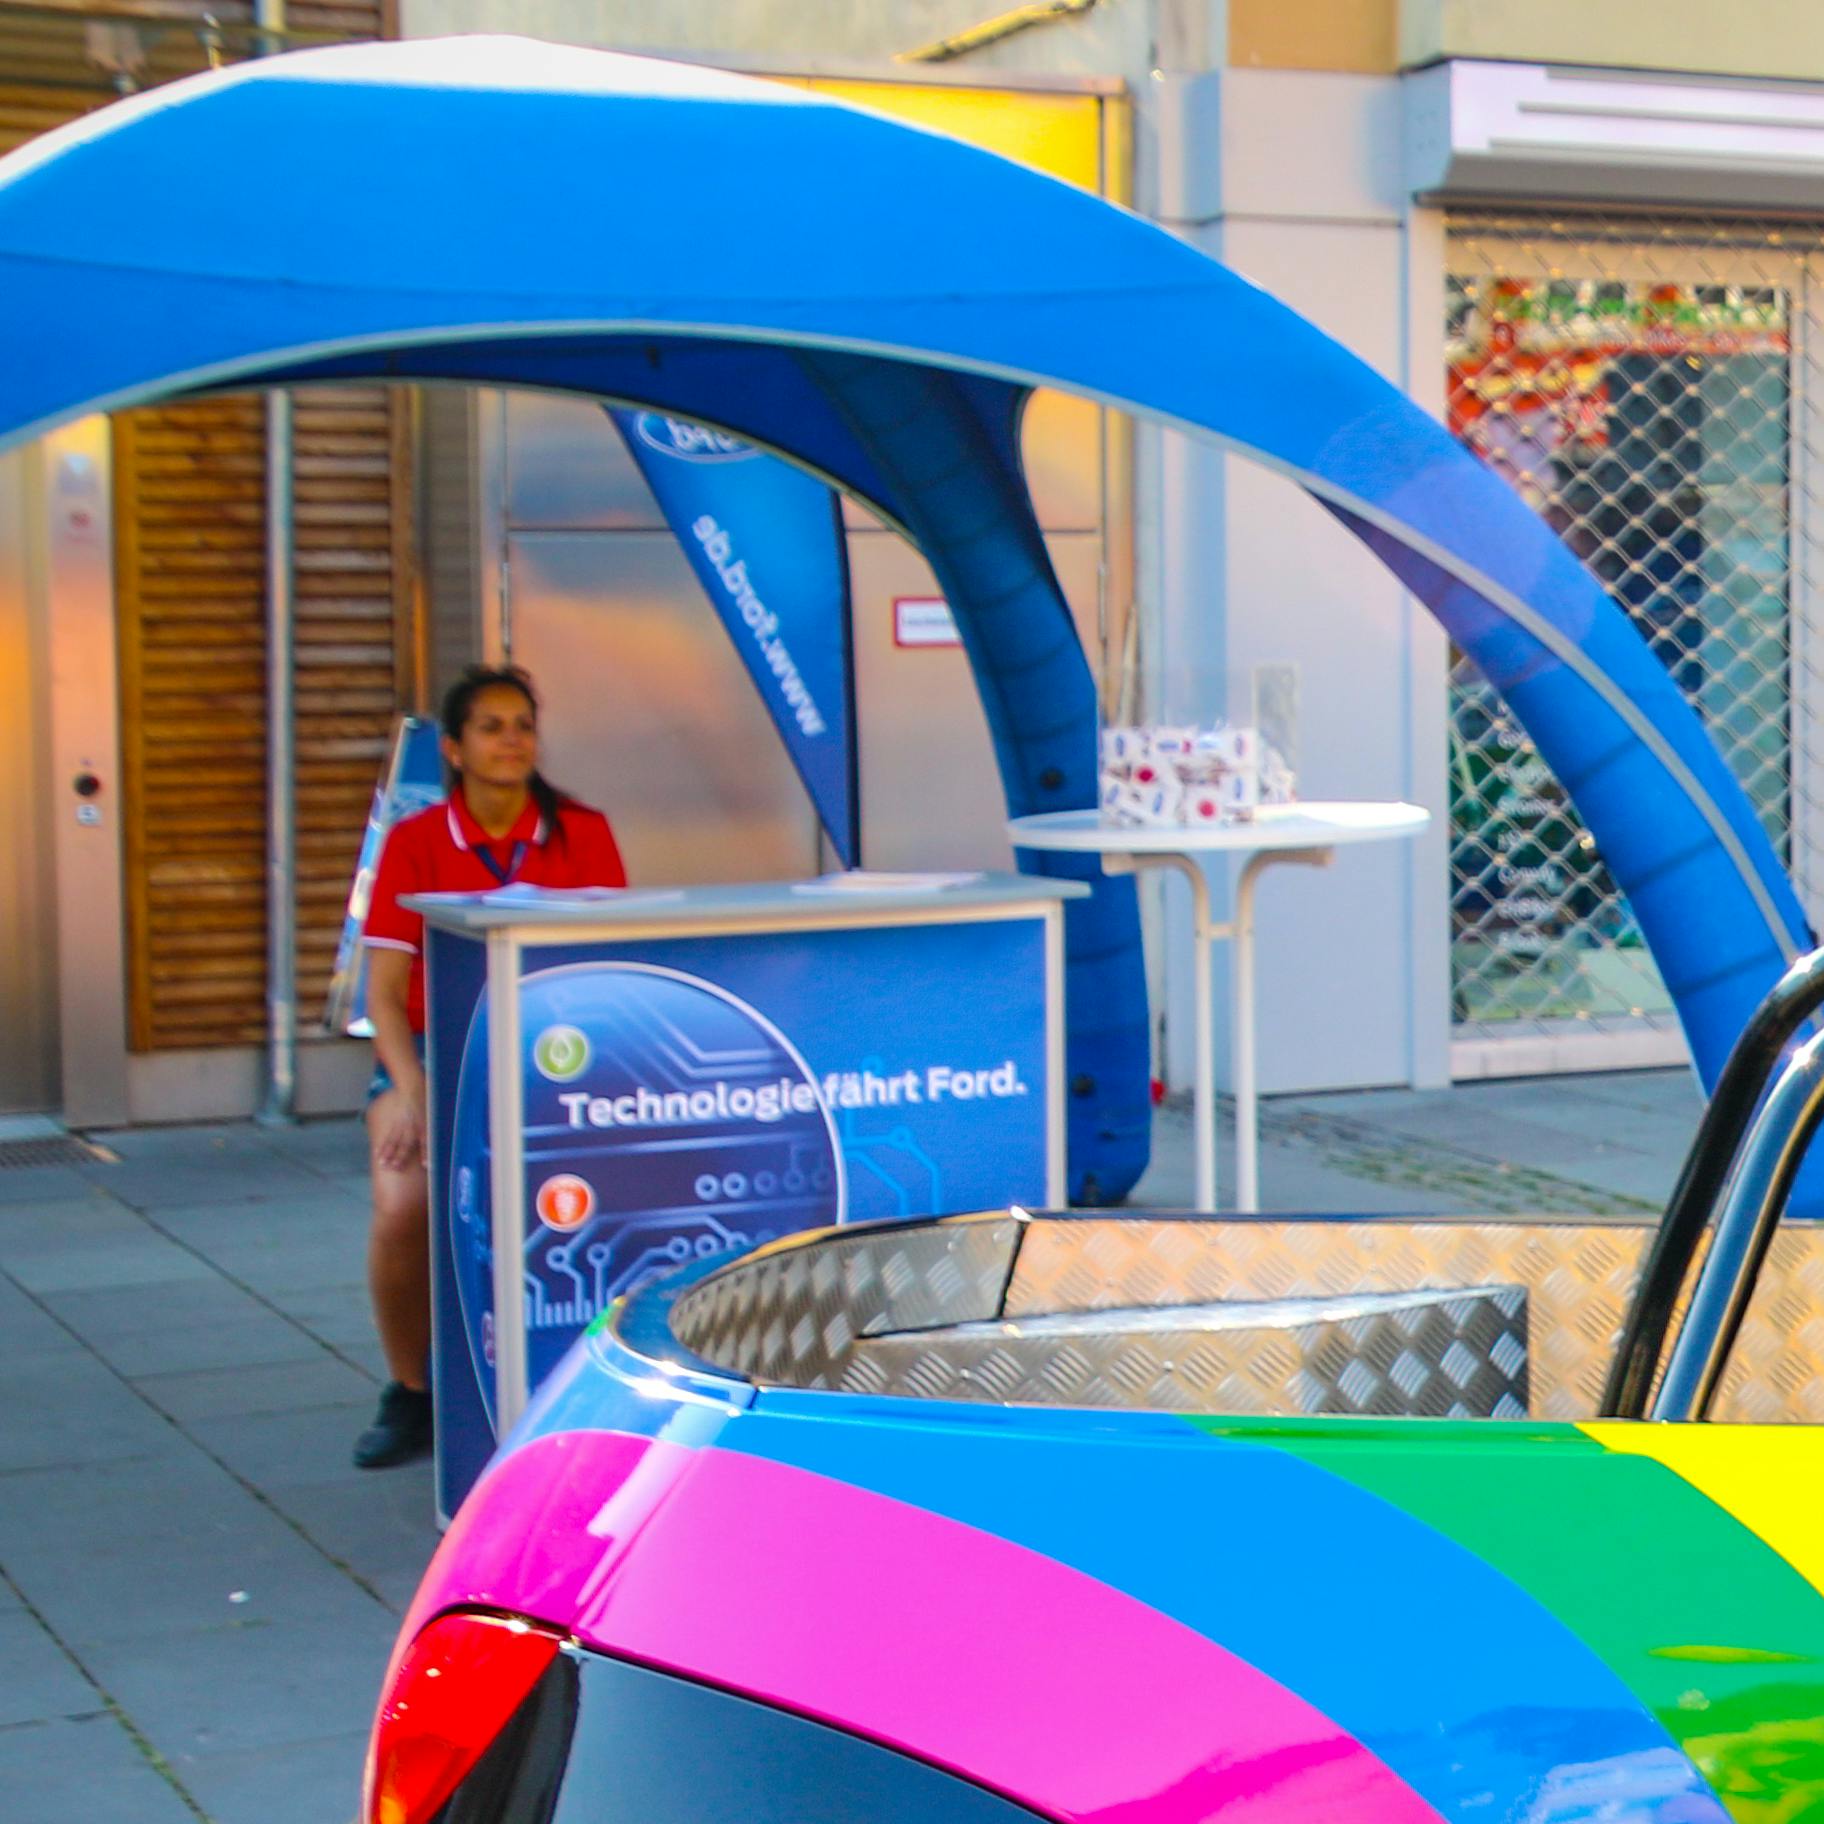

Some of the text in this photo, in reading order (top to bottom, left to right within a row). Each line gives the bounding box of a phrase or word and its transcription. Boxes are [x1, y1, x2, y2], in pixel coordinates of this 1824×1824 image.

[558, 1059, 1028, 1128] Technologie fährt Ford.
